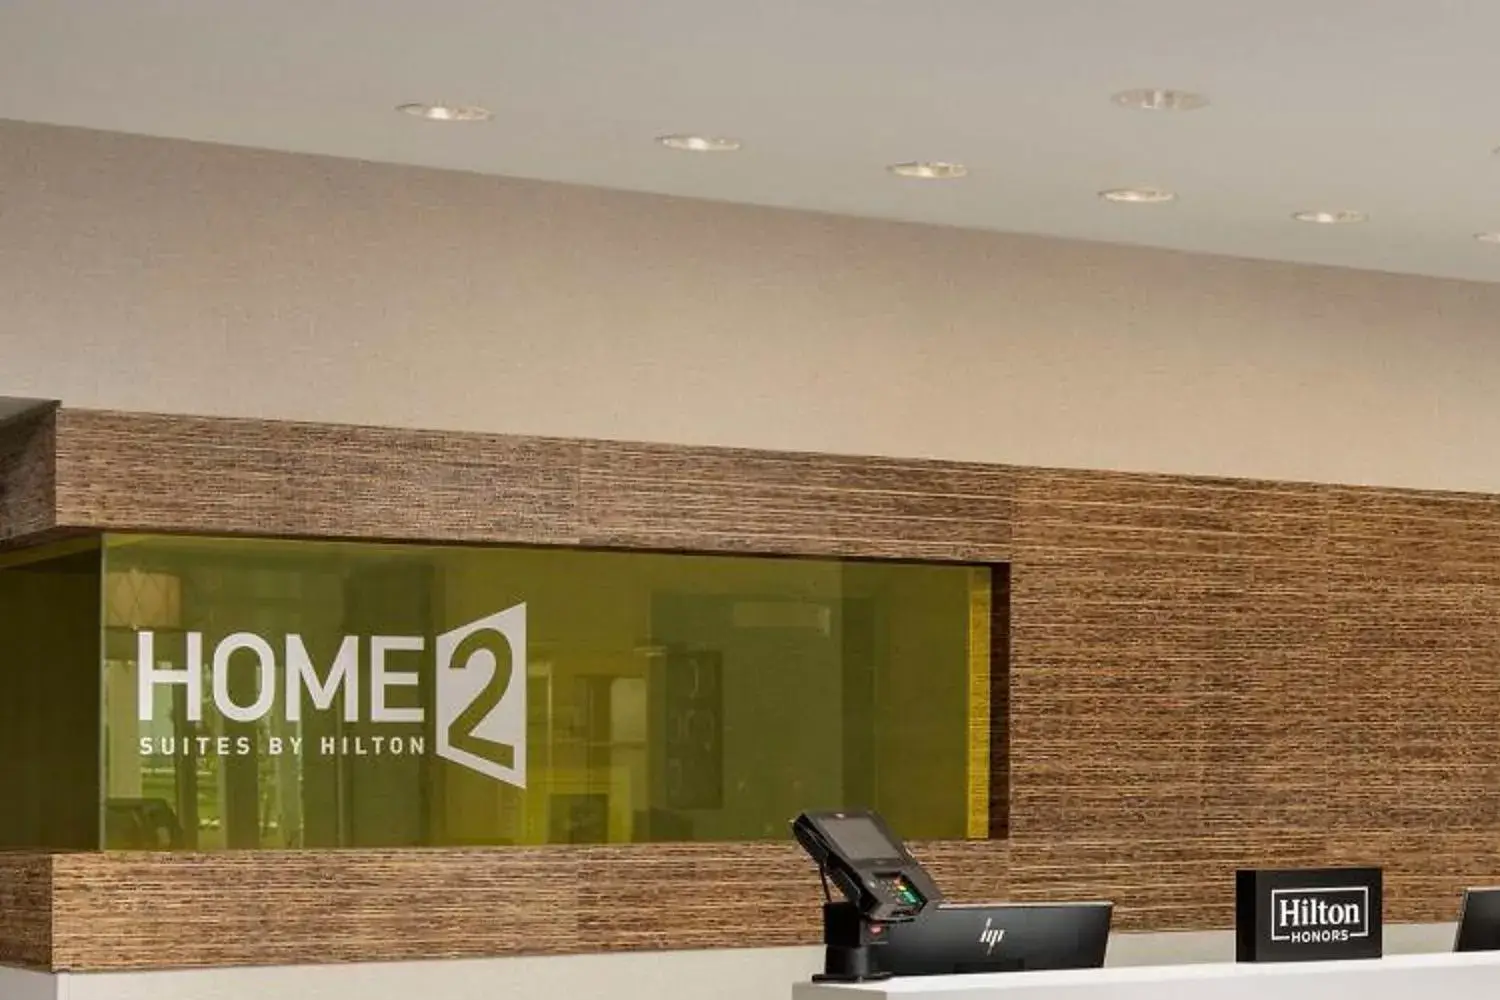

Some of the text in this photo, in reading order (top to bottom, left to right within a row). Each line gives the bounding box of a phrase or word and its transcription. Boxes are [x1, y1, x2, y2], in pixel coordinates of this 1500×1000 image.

[139, 736, 426, 756] SUITES BY HILTON
[1279, 898, 1361, 927] Hilton
[979, 917, 1005, 956] hp
[1291, 930, 1350, 943] HONORS
